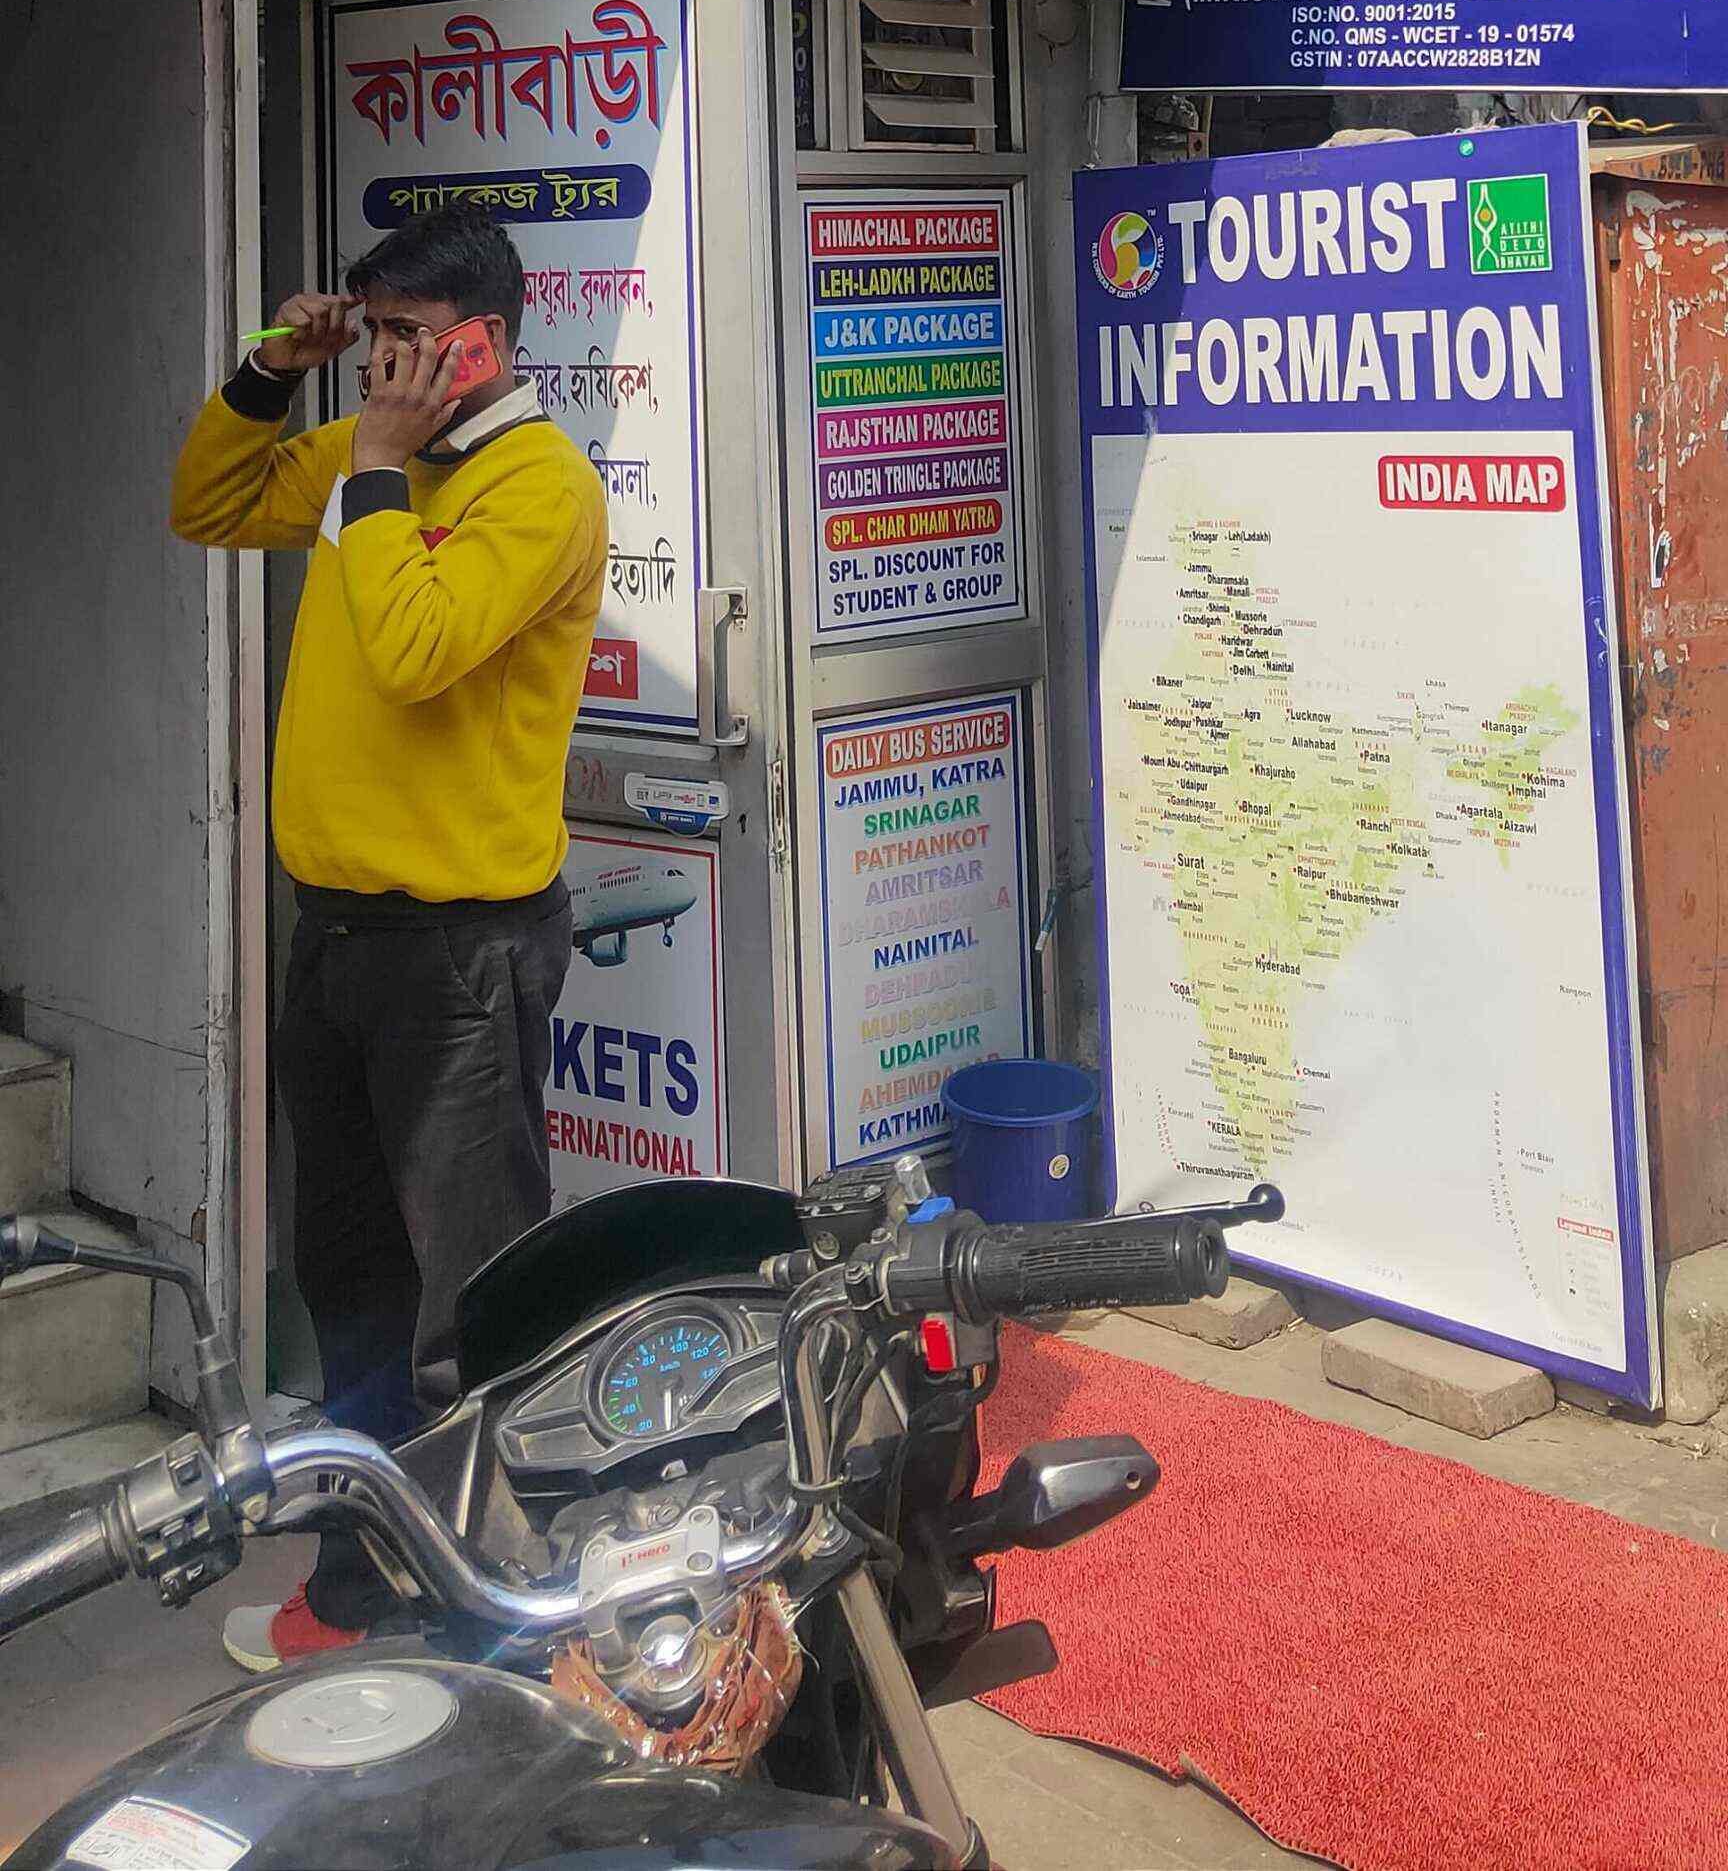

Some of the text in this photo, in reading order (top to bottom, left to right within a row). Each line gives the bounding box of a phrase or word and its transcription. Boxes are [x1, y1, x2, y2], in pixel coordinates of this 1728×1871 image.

[1291, 3, 1456, 23] ISO:NO. 9001:2015
[1290, 23, 1576, 46] C.NO. QMS WCET 19 01574
[1290, 48, 1541, 68] GSTIN 07AACCW2828B1ZN
[818, 216, 993, 249] HIMACHAL PACKAGE
[1168, 177, 1457, 284] TOURIST
[820, 264, 995, 299] LEH-LADKH PACKAGE
[824, 311, 994, 349] J&K PACKAGE
[1099, 303, 1564, 408] INFORMATION
[820, 359, 1001, 399] UTTRANCHAL PACKAGE
[825, 408, 1000, 450] RAJSTHAN PACKAGE
[828, 456, 1001, 501] GOLDEN TRINGLE PACKAGE
[1384, 462, 1559, 506] INDIA MAP
[832, 505, 996, 545] SPL. CHAR DHAM YATRA
[829, 542, 1005, 584] SPL. DISCOUNT FOR
[1187, 564, 1212, 573] Jammu
[833, 573, 1003, 616] STUDENT & GROUP
[1243, 625, 1284, 637] Dehradun
[1232, 666, 1255, 676] Delhi
[1290, 709, 1331, 724] Lucknow
[1485, 719, 1527, 735] Itanagar
[831, 715, 1005, 772] DAILY BUS SERVICE
[1291, 736, 1336, 751] Allahabad
[1363, 752, 1390, 764] Patna
[1254, 763, 1296, 780] Khajuraho
[1526, 771, 1566, 788] Kohima
[834, 757, 1006, 809] JAMMU, KATRA
[863, 794, 980, 837] SRINAGAR
[1241, 800, 1272, 817] Bhopal
[1460, 803, 1503, 821] Agartala
[1503, 820, 1537, 835] Aizawl
[853, 824, 991, 875] PATHANKOT
[1390, 842, 1428, 858] Kolkata
[1177, 853, 1205, 870] Surat
[865, 858, 985, 905] AMRITSAR
[1297, 865, 1327, 880] Raipur
[1329, 888, 1399, 909] Bhubaneshwar
[873, 926, 980, 970] NAINITAL
[1255, 957, 1301, 976] Hyderabad
[879, 1024, 982, 1072] UDAIPUR
[1228, 1048, 1267, 1066] Bangaluru
[552, 1016, 699, 1117] KETS
[1302, 1067, 1331, 1079] Chennai
[1211, 1120, 1242, 1138] KERALA
[1180, 1161, 1255, 1181] Thiruvanathapuram
